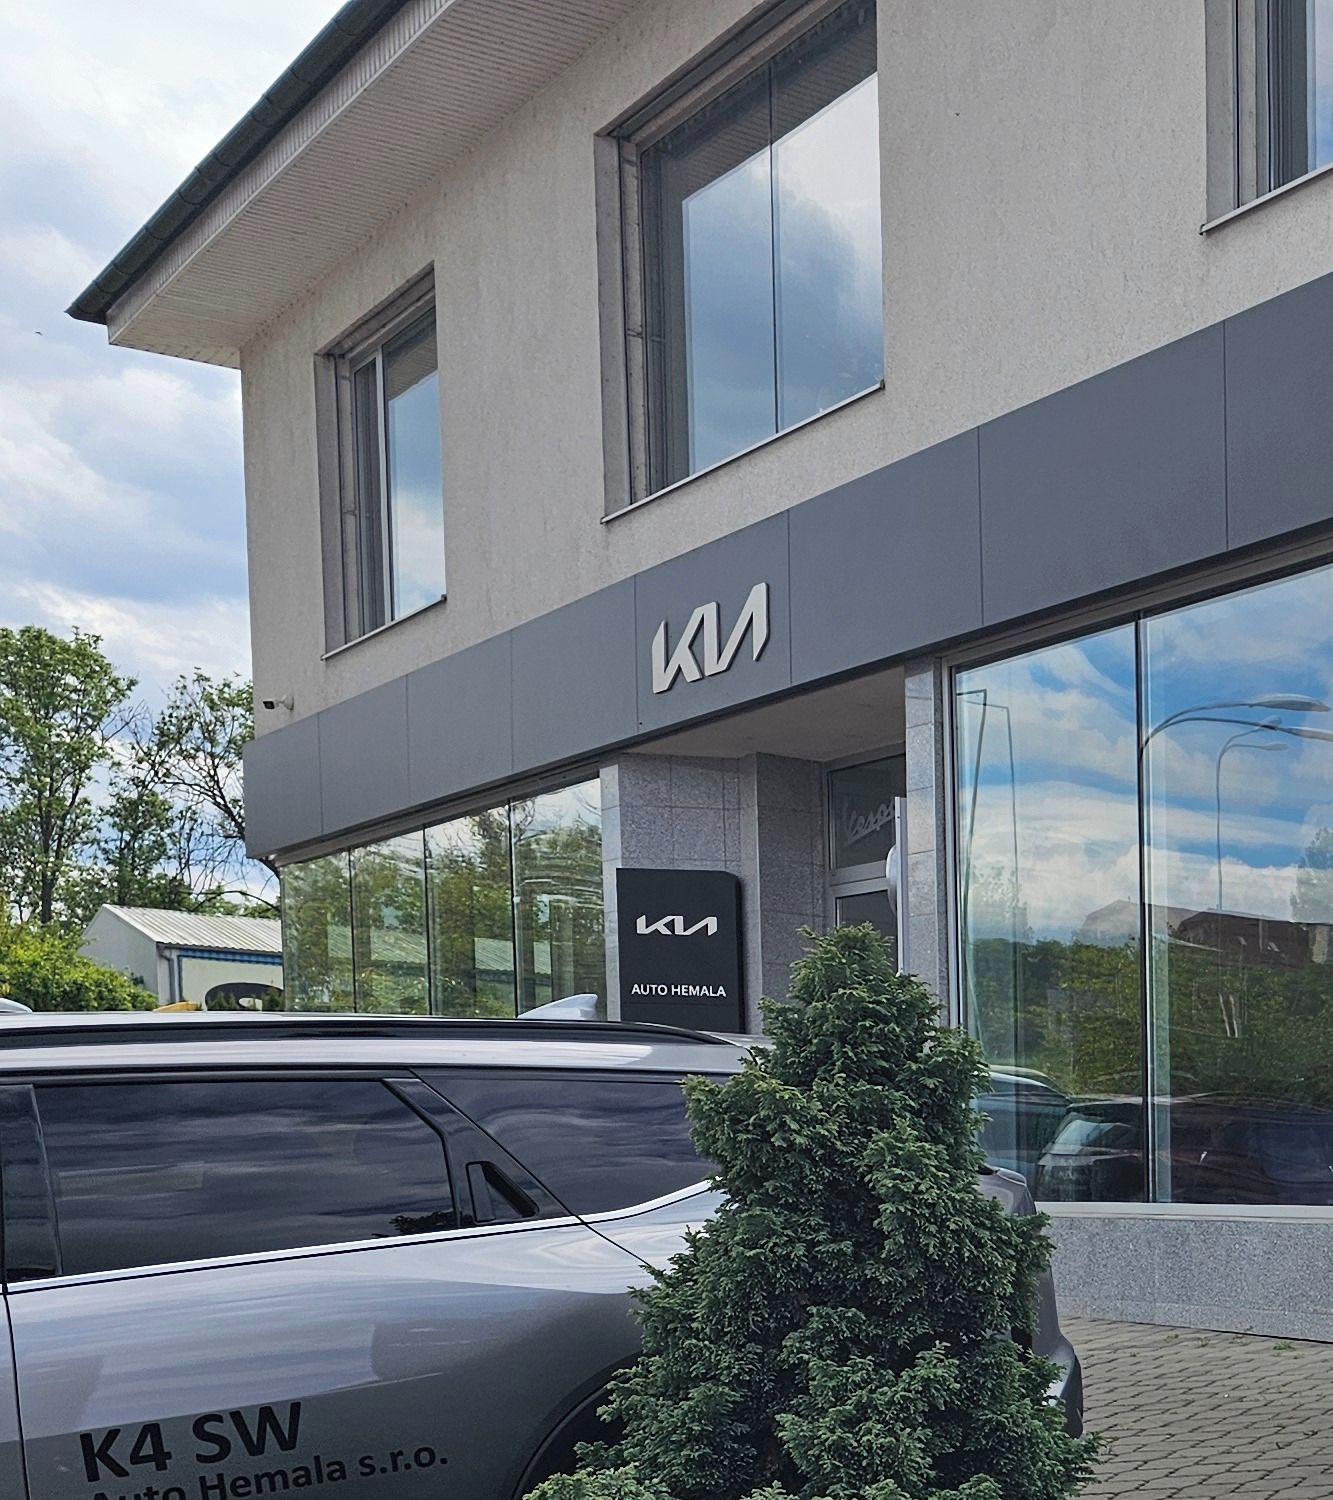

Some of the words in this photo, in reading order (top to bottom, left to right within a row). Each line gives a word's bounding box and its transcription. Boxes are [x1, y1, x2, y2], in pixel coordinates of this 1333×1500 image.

[631, 983, 668, 996] AUTO
[671, 984, 727, 997] HEMALA
[79, 1422, 172, 1483] K4
[191, 1401, 302, 1464] SW
[358, 1445, 449, 1478] s.r.o.
